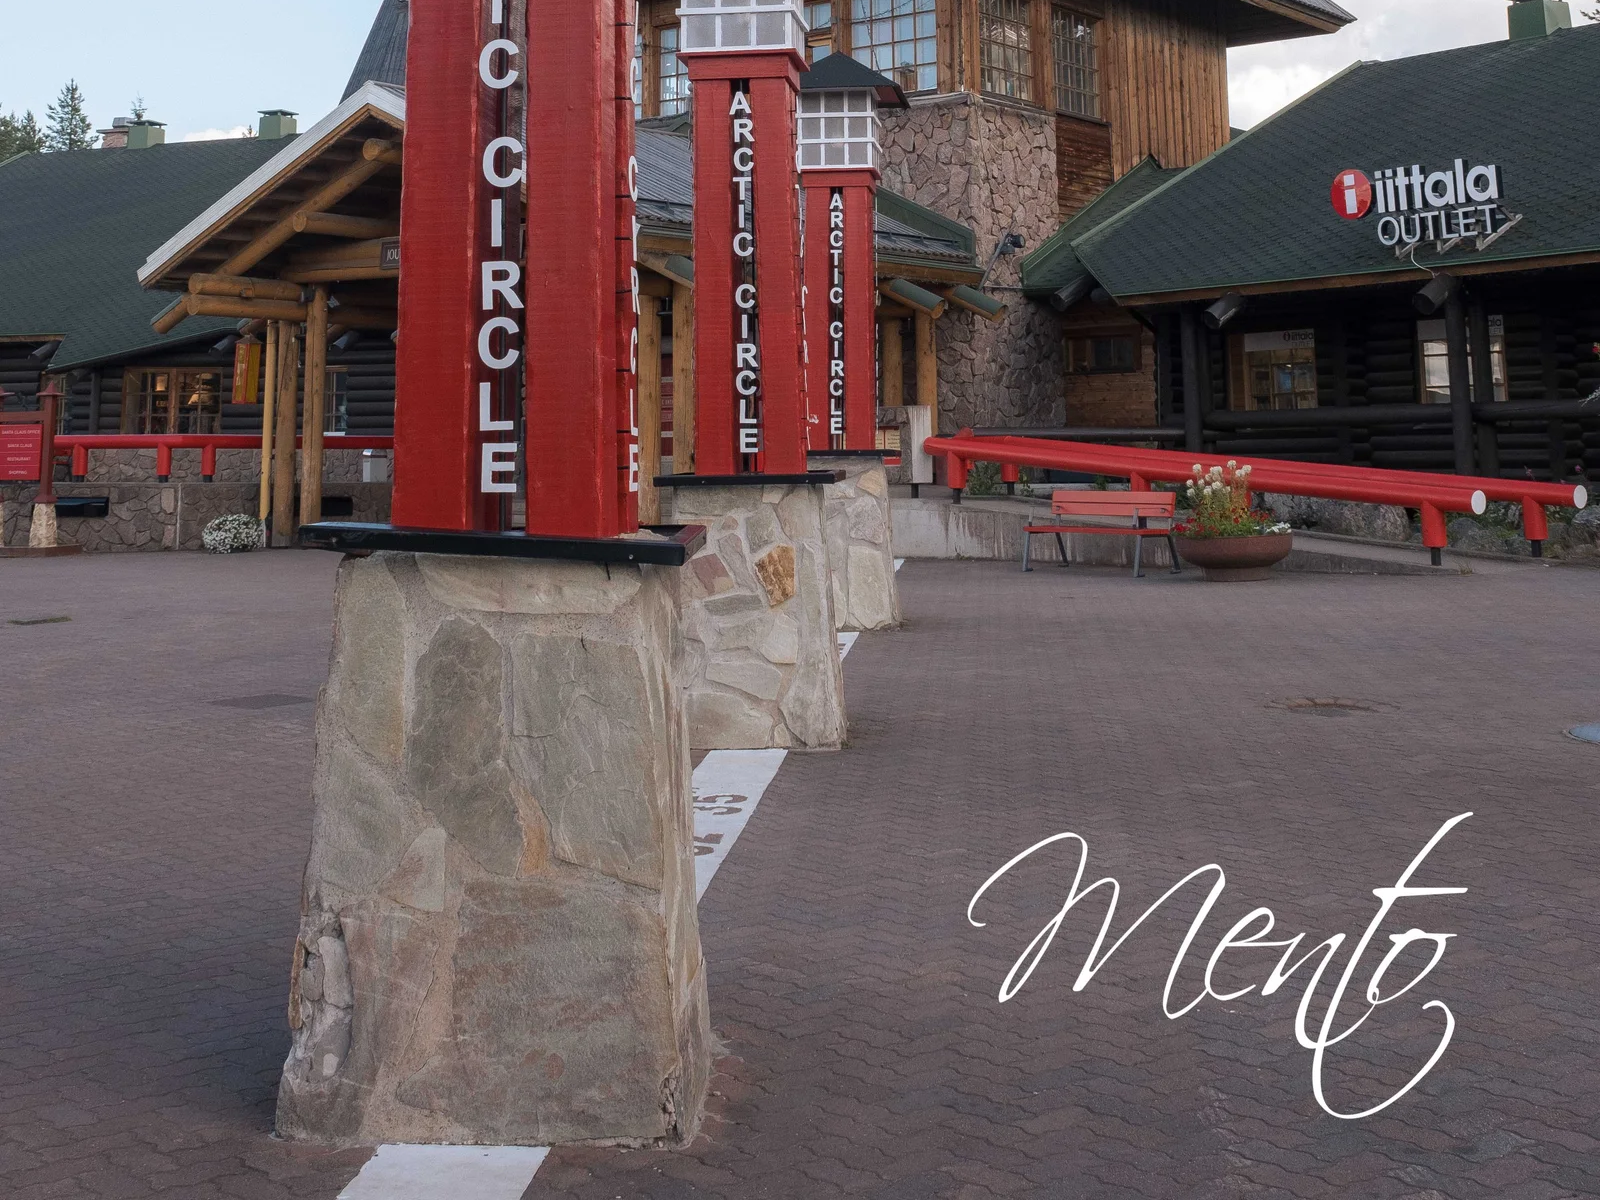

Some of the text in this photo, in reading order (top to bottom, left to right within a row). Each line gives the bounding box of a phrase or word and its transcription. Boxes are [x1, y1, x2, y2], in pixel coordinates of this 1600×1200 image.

[729, 91, 759, 453] ARCTIC CIRCLE
[1374, 158, 1499, 213] iittala
[1377, 203, 1497, 245] OUTLET
[478, 136, 524, 493] CIRCLE
[829, 193, 845, 434] ARCTIC CIRCLE
